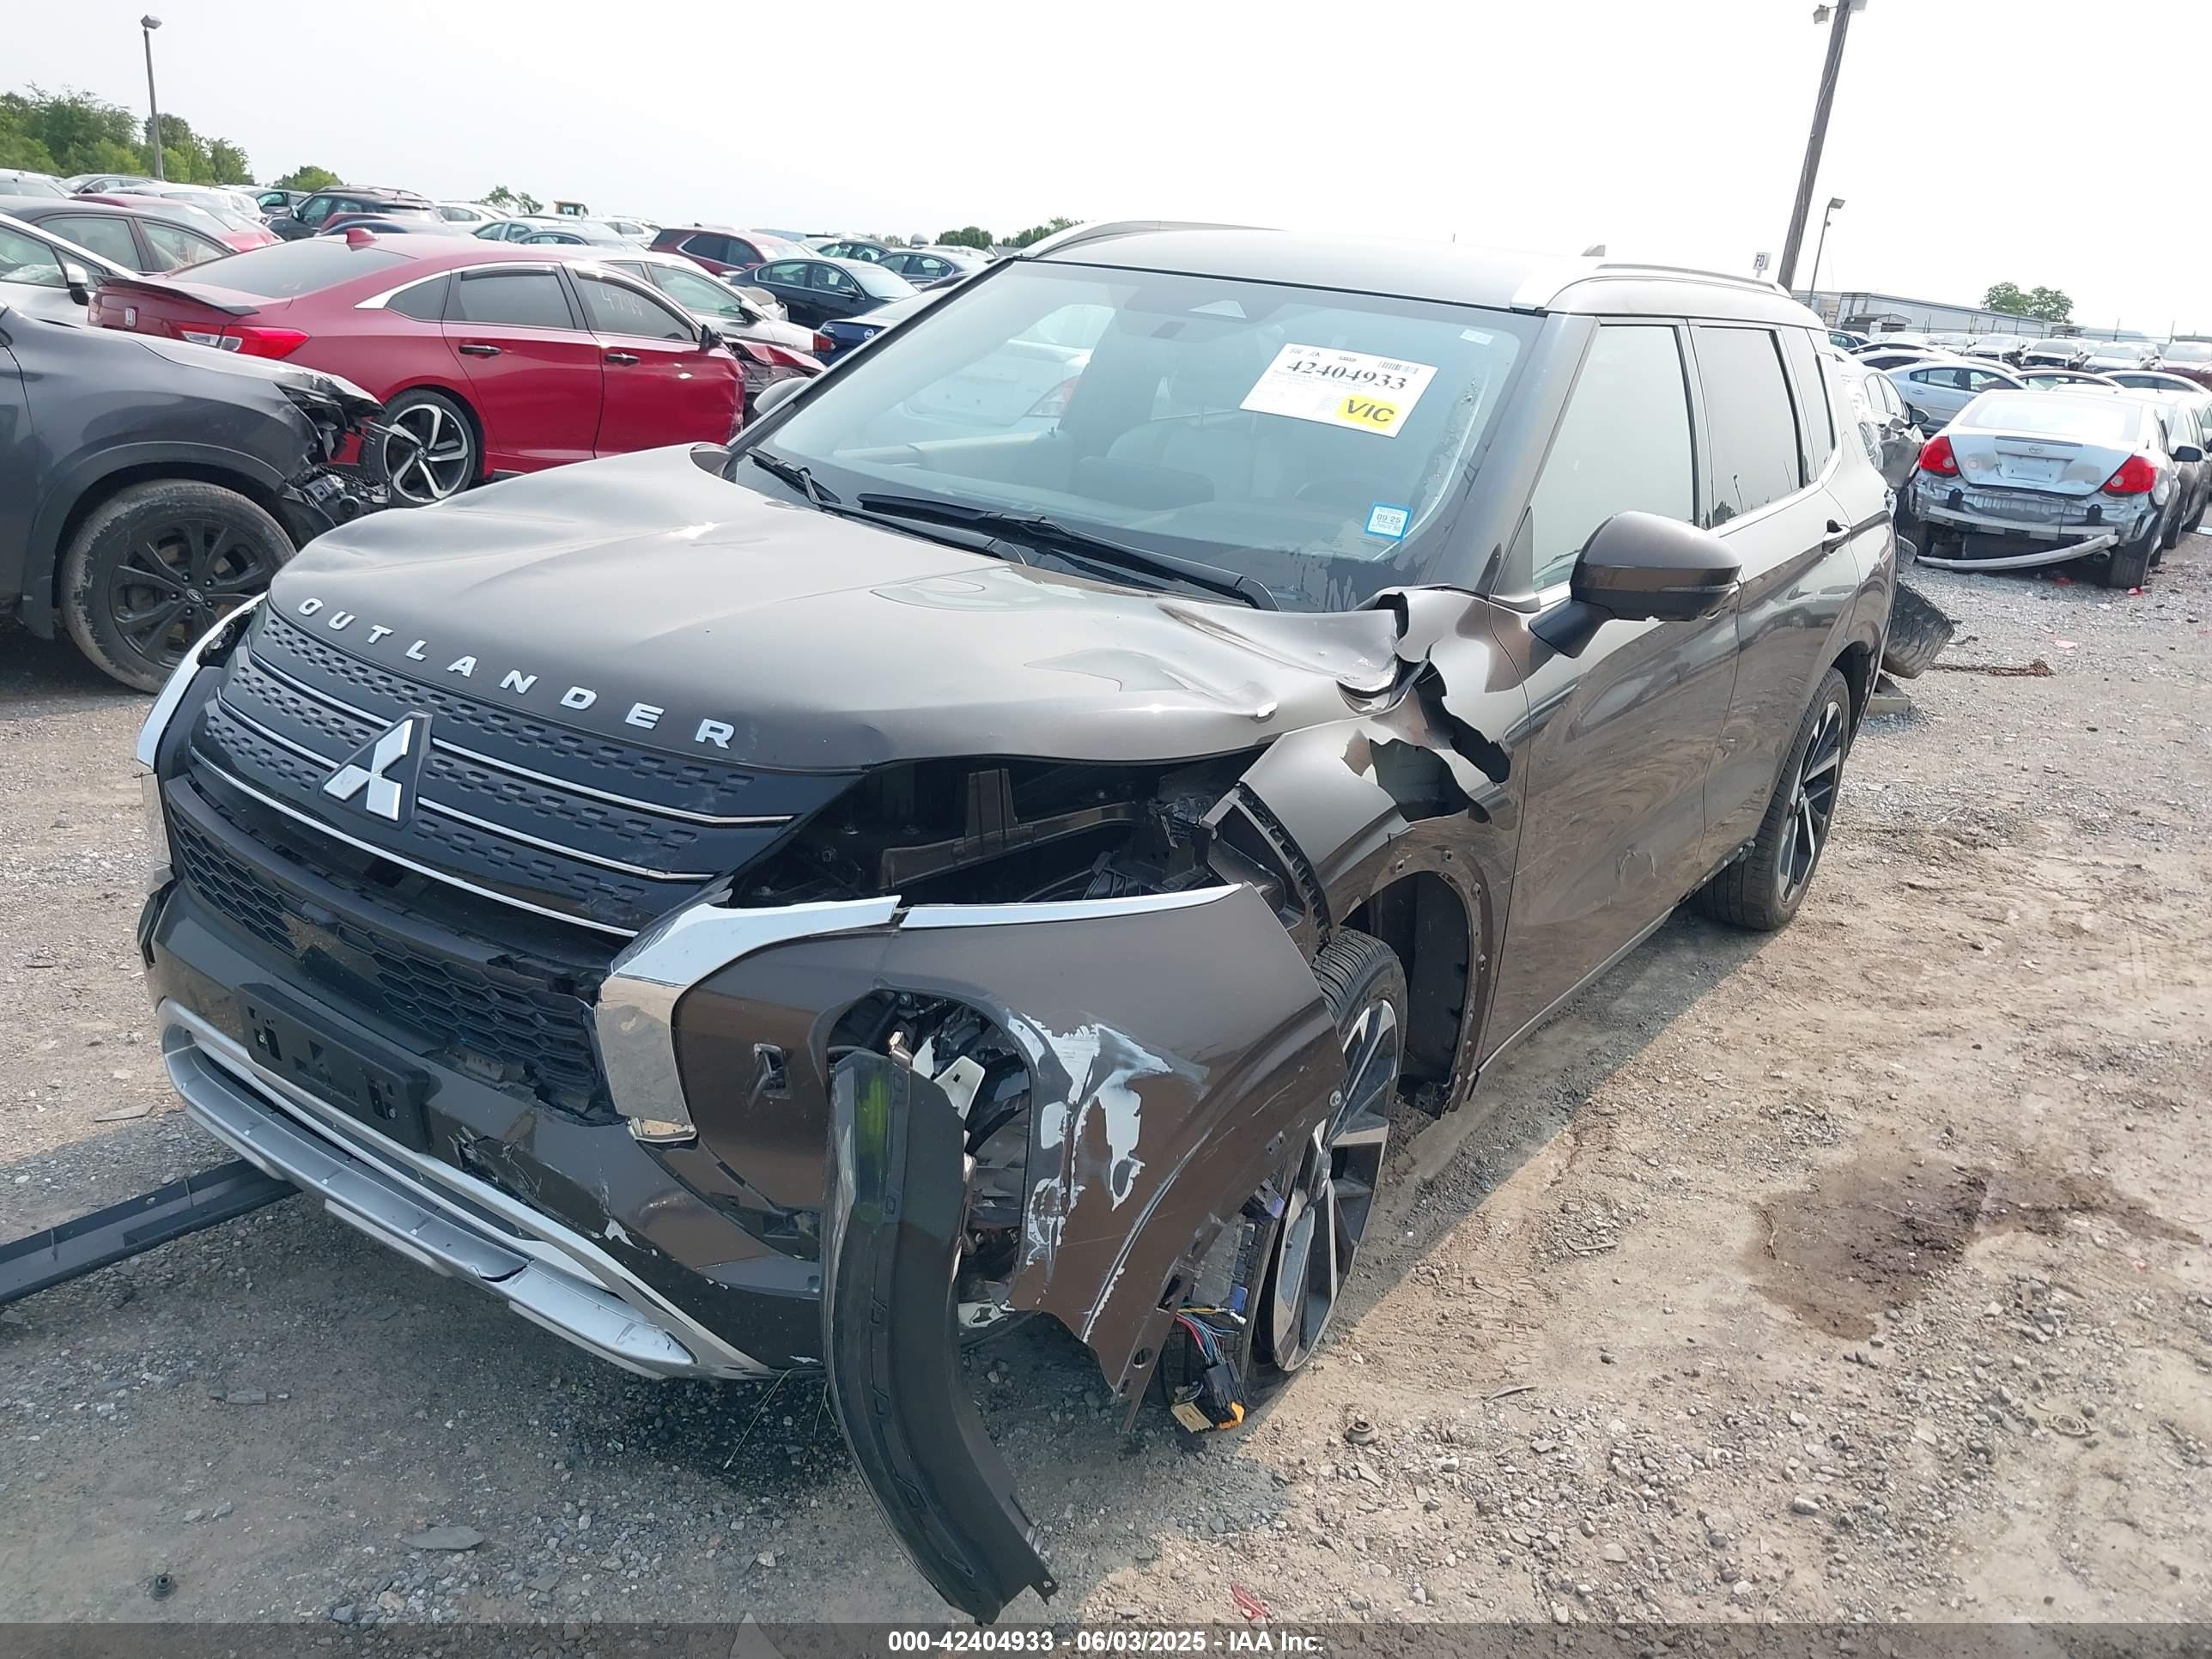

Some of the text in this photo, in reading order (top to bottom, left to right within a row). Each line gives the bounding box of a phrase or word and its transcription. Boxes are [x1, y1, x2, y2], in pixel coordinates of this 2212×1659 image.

[1286, 360, 1407, 390] 42404933
[1347, 399, 1395, 422] VIC
[297, 597, 737, 750] OUTLANDER
